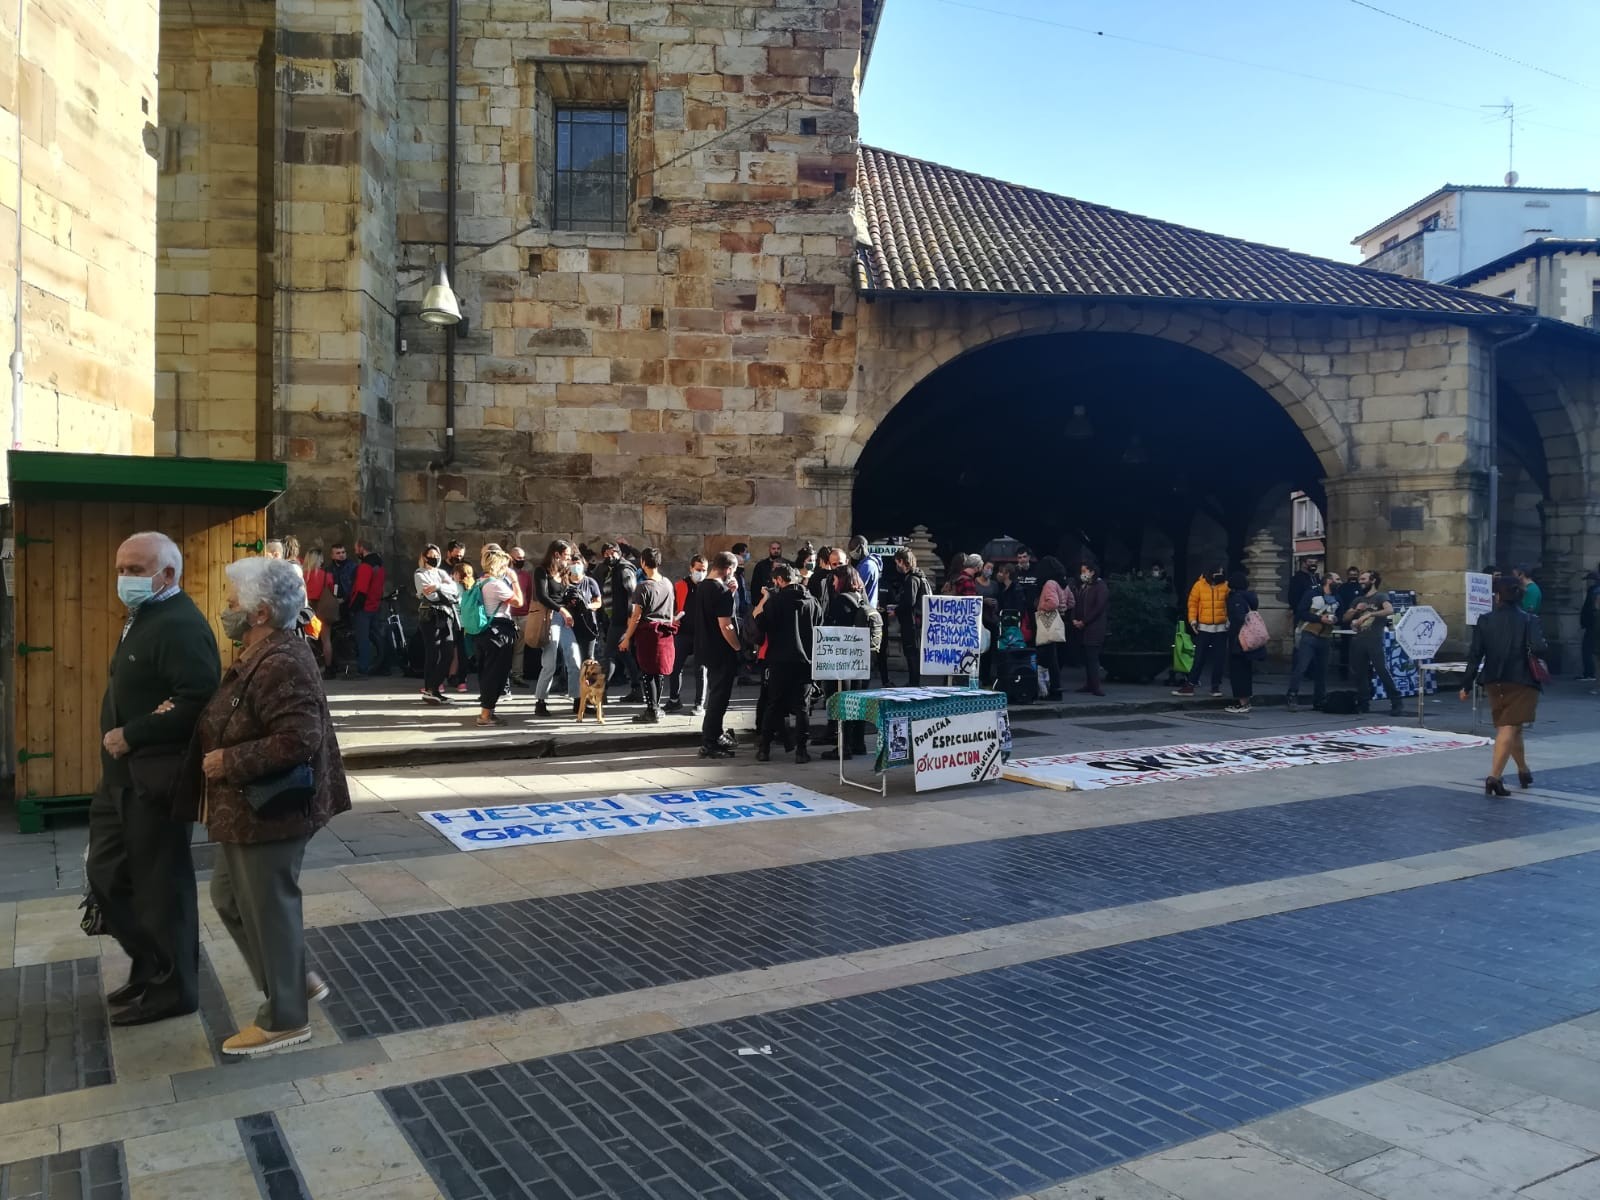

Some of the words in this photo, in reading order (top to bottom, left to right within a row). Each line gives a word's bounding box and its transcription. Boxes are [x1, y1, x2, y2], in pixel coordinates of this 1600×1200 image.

[928, 597, 983, 617] MIGRANTES
[928, 613, 977, 626] SUDAKAS
[932, 726, 997, 749] ESPECULACIÓN
[432, 798, 624, 824] HERRI
[461, 811, 700, 841] GAZTETXE
[704, 800, 814, 820] BAT!
